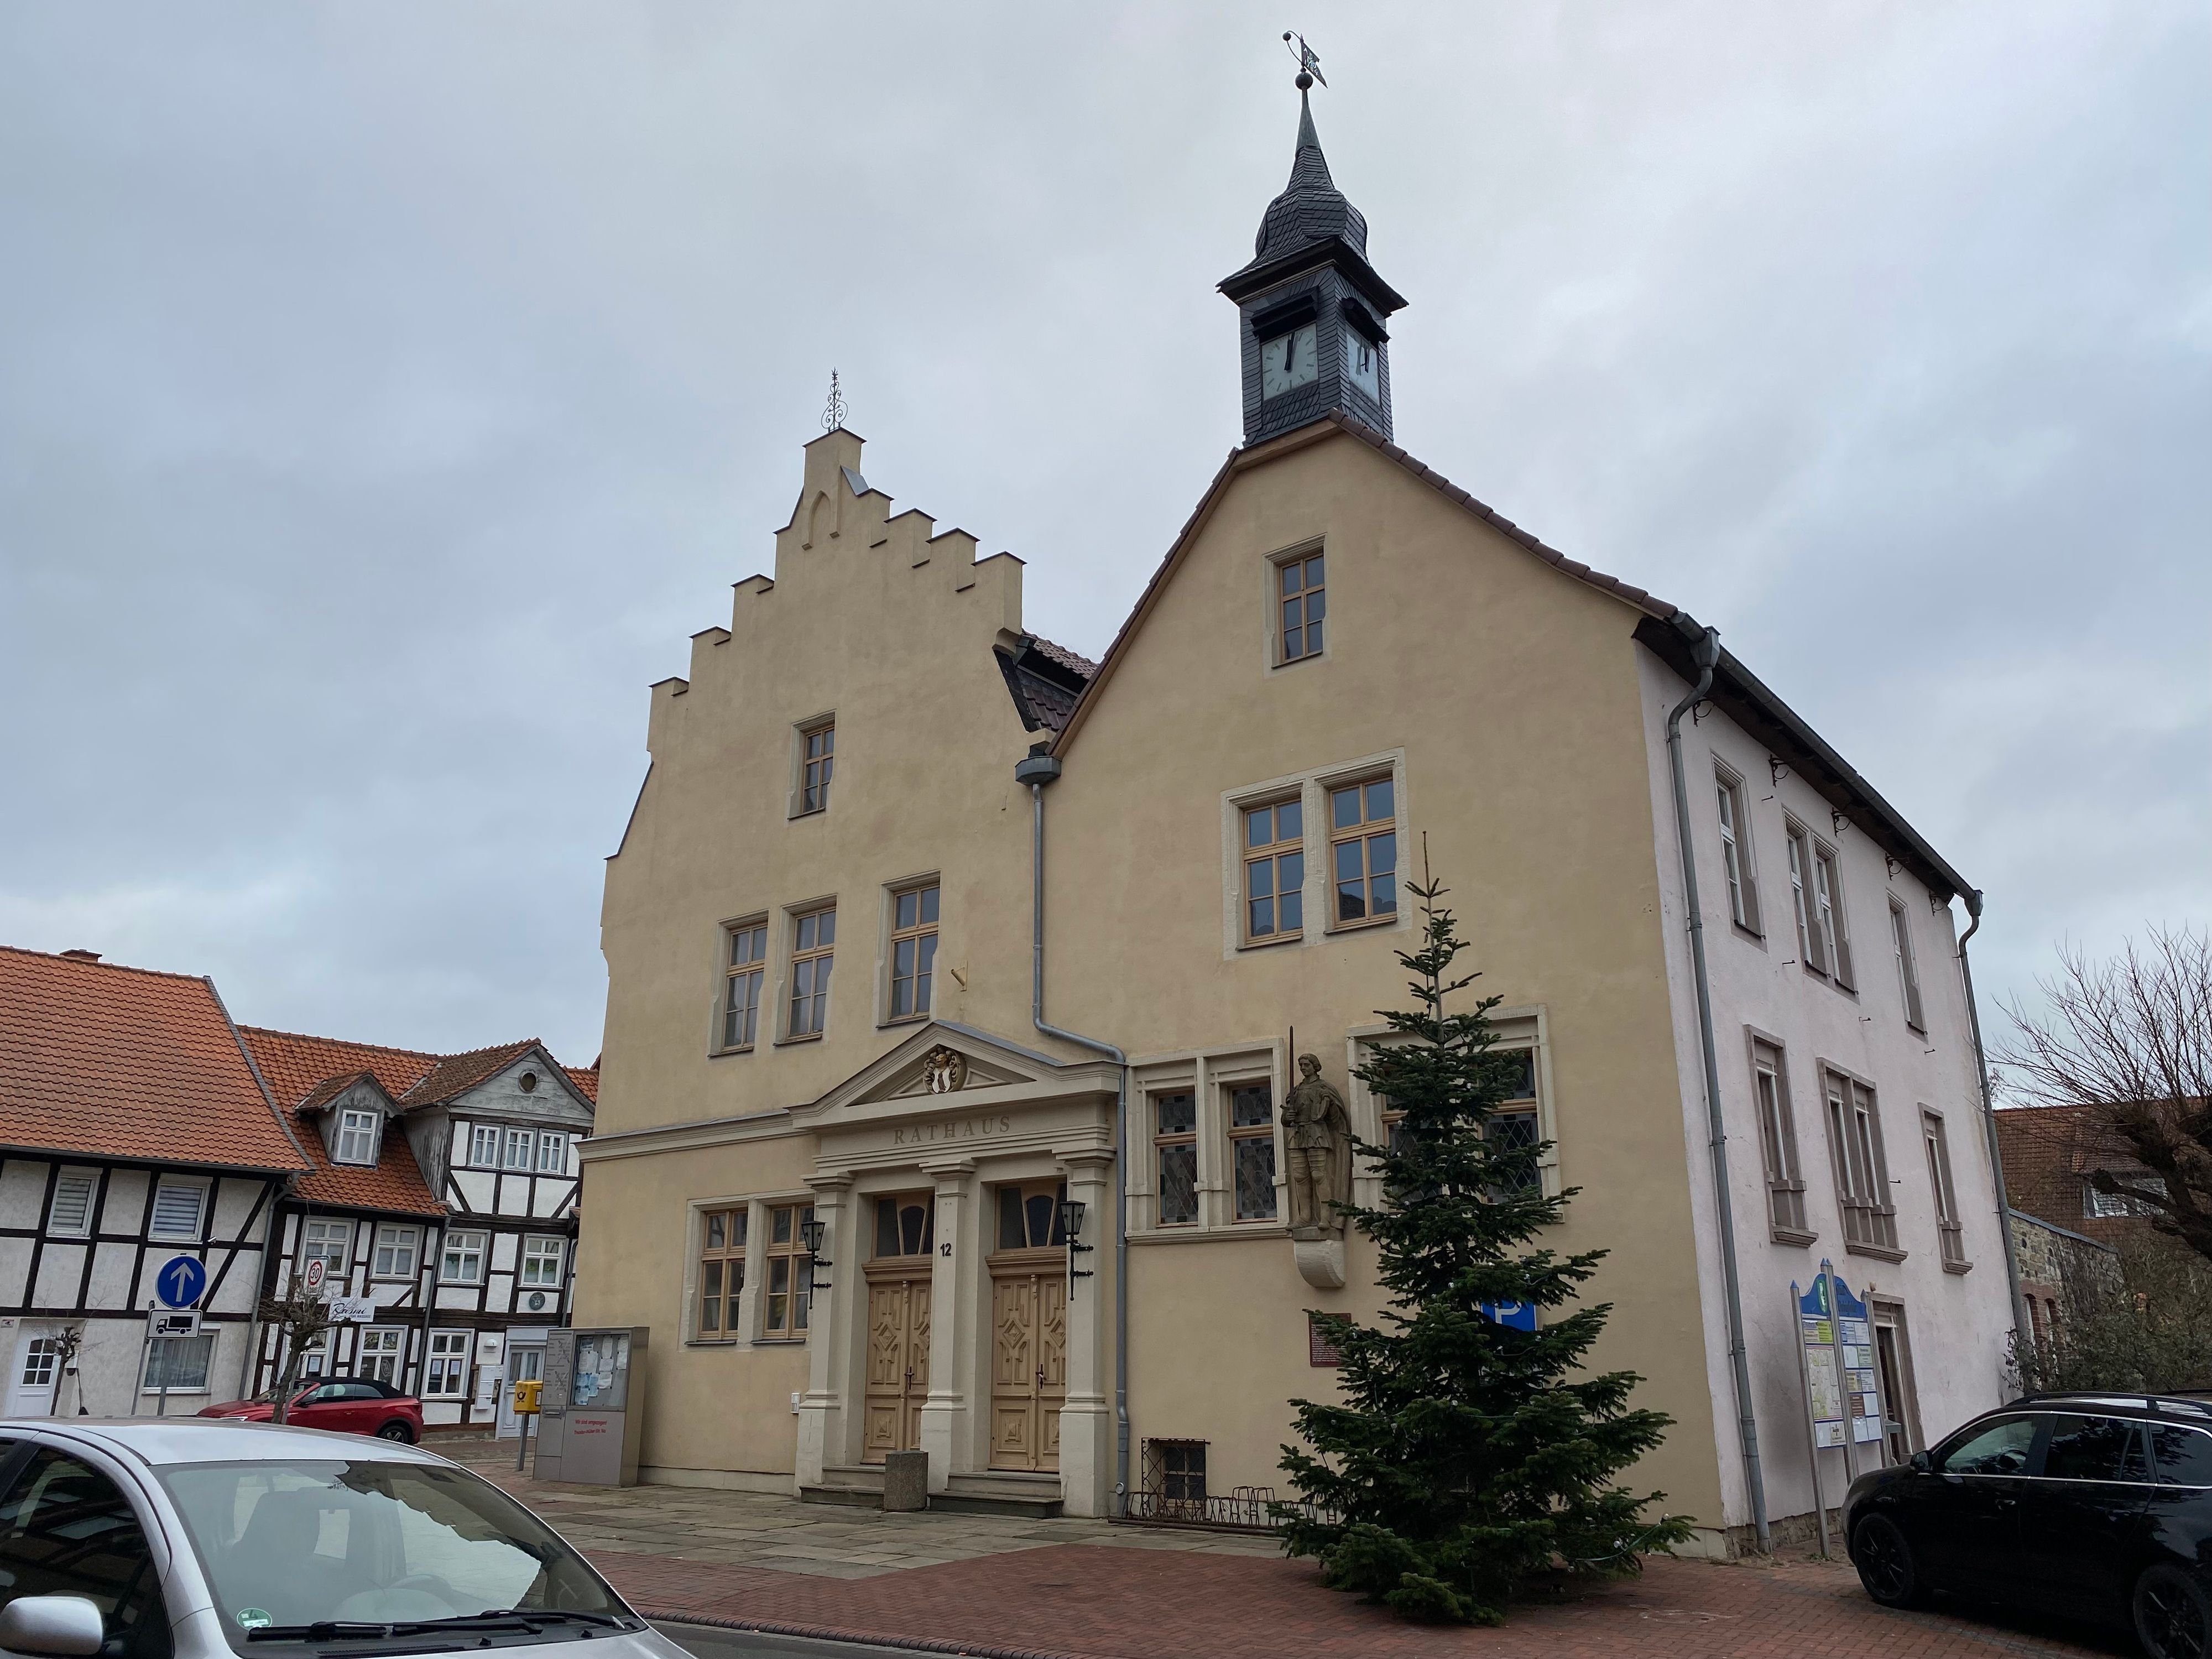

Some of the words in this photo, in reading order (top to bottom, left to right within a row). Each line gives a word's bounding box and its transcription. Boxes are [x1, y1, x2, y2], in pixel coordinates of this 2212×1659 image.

[894, 1116, 1010, 1145] RATHAUS
[940, 1243, 951, 1256] 12
[311, 1267, 320, 1279] 30
[333, 1303, 367, 1314] Rasmi
